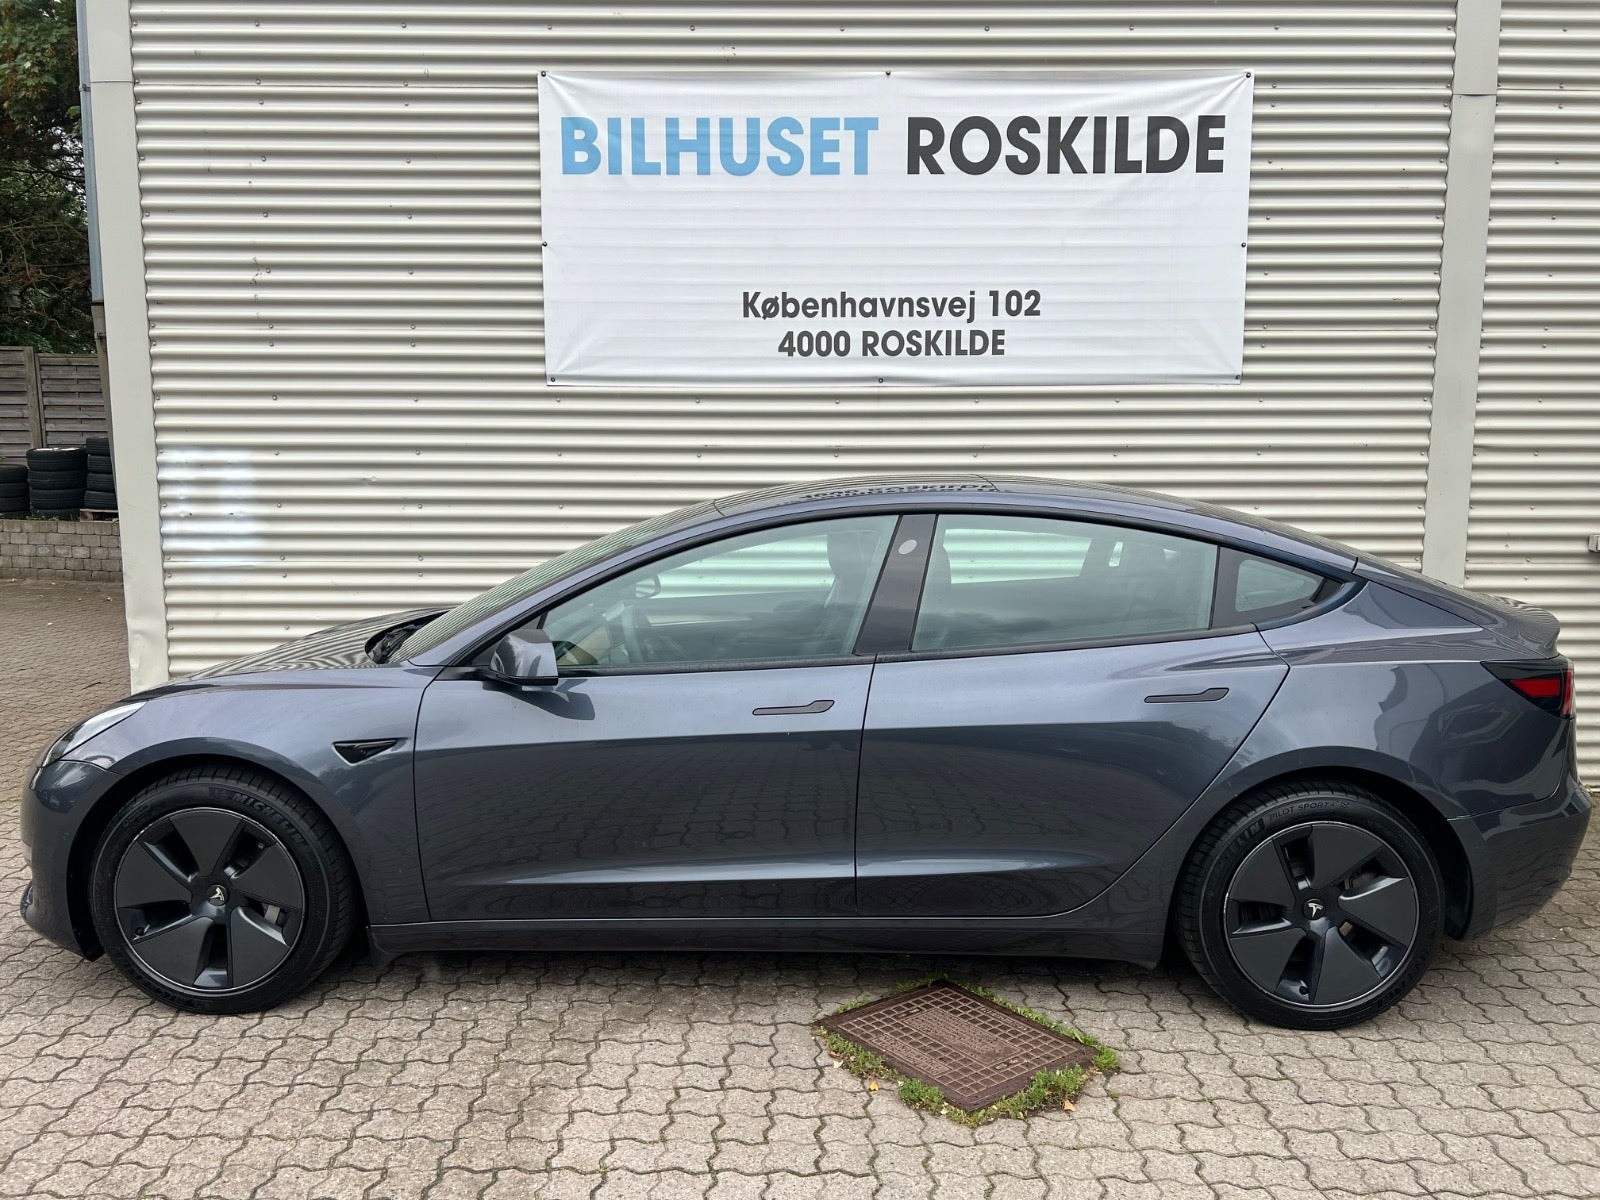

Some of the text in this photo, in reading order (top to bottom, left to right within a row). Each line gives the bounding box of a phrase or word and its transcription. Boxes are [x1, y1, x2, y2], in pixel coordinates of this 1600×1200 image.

[561, 115, 1226, 176] BILHUSET ROSKILDE
[743, 290, 1041, 323] Københavnsvej 102
[778, 330, 1006, 358] 4000 ROSKILDE
[232, 791, 306, 846] MICHELIN
[1269, 806, 1294, 820] PILOT
[1298, 801, 1329, 811] SPORT
